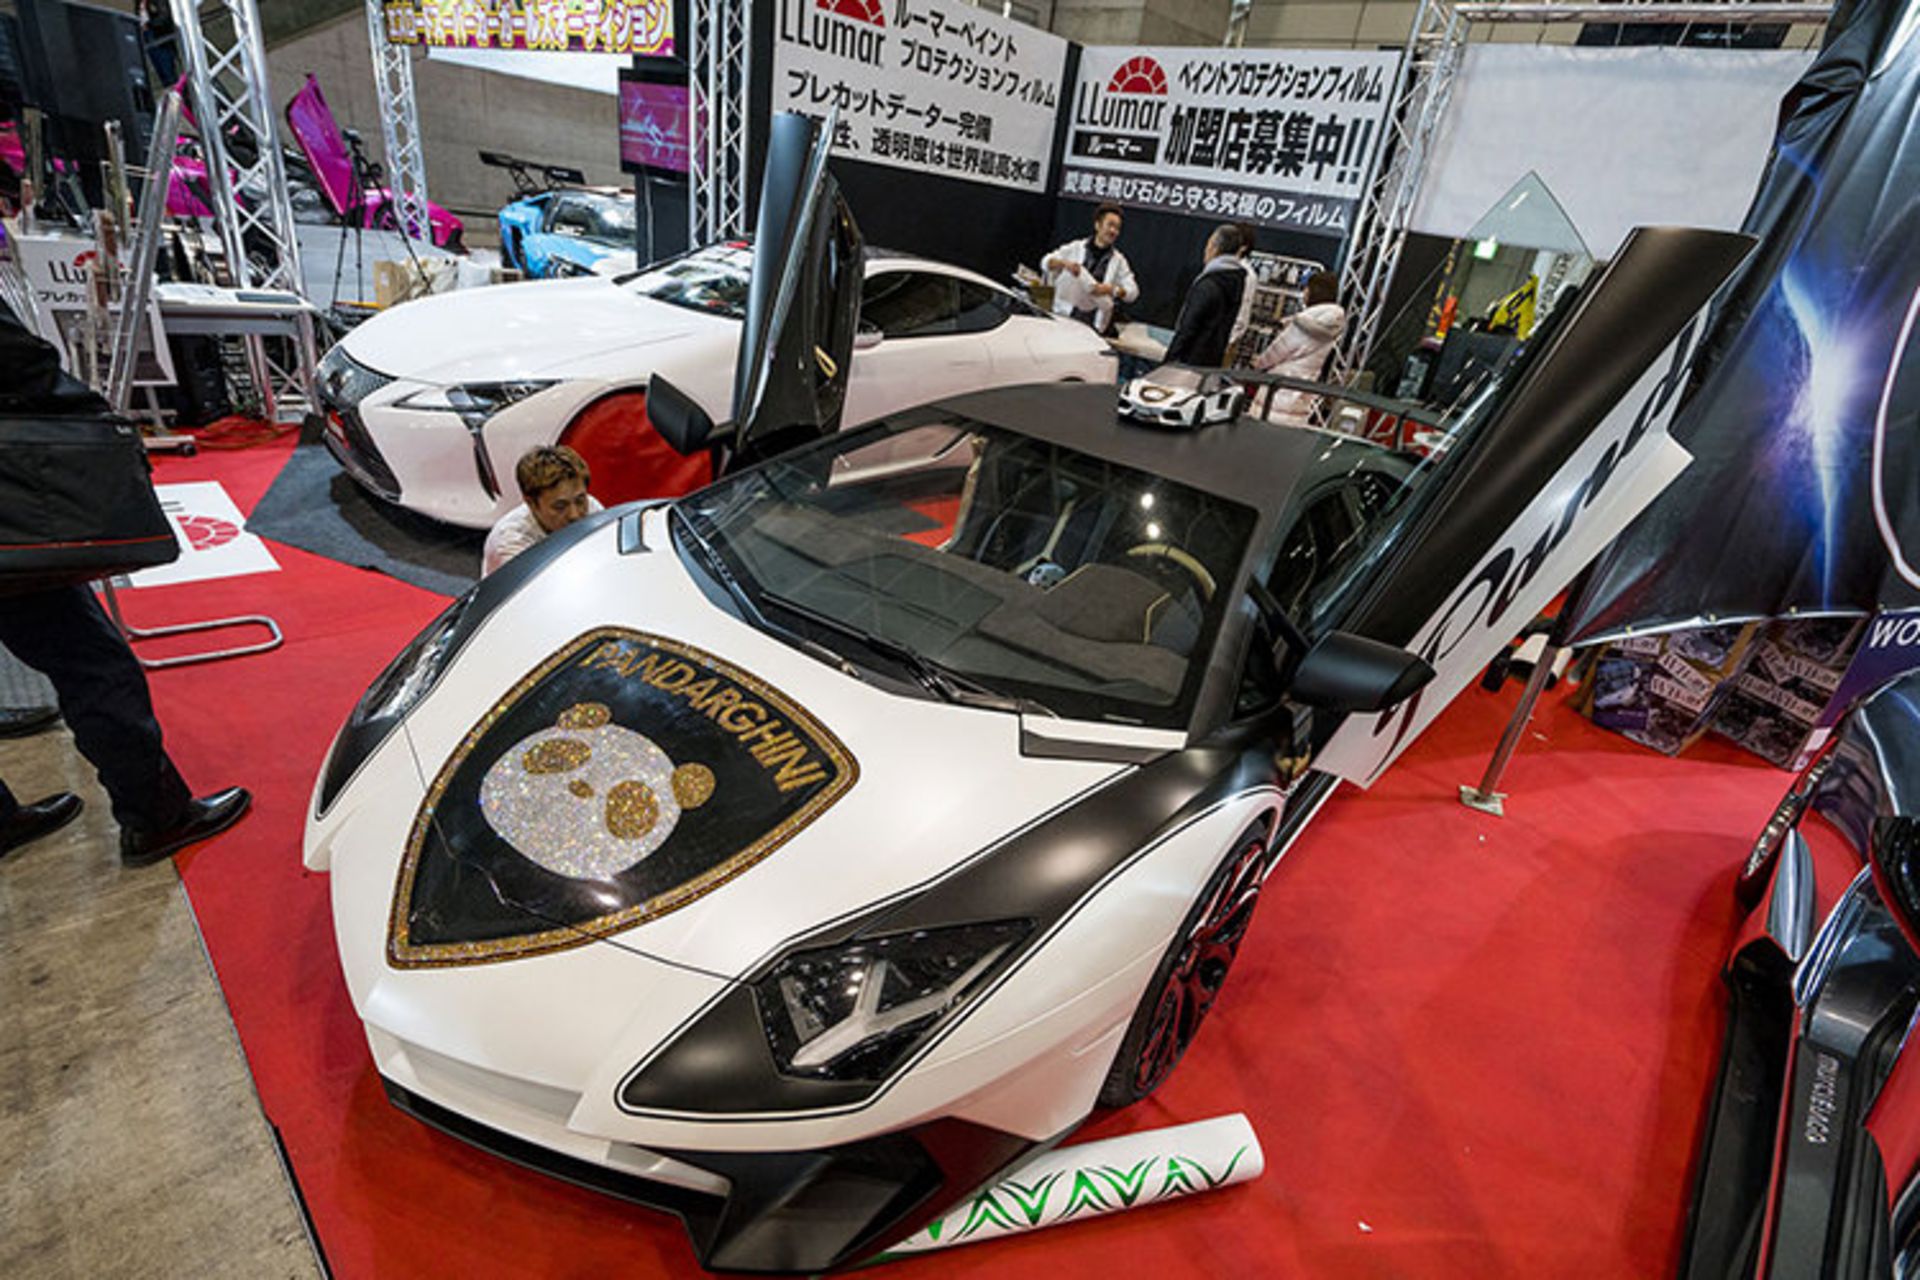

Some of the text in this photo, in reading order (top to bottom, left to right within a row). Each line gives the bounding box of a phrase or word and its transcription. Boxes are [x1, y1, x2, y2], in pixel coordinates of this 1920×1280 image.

[780, 0, 886, 66] LLumar
[893, 0, 1017, 62] ルーマーペイント
[900, 38, 1056, 108] プロテクションフィルム
[1178, 60, 1384, 103] ペイントプロテクションフィルム
[1076, 81, 1166, 132] LLumar
[1087, 134, 1143, 156] ルーマー
[1869, 618, 1920, 648] WO
[579, 641, 827, 793] PANDARGHINI
